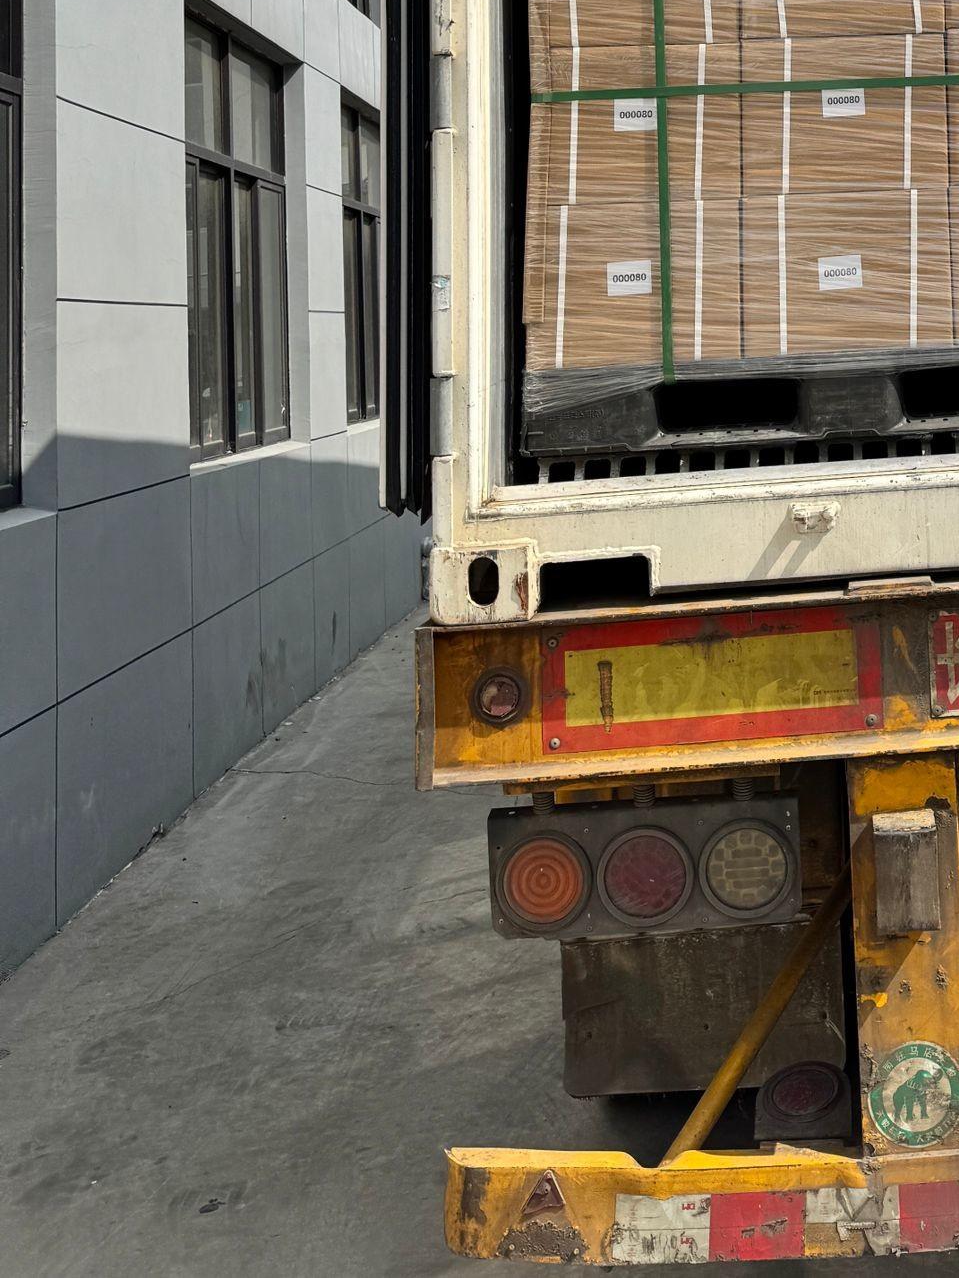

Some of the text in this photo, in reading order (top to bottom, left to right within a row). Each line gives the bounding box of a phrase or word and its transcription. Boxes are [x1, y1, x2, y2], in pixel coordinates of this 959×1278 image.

[827, 95, 860, 106] 000080
[619, 109, 654, 120] 000080
[612, 272, 647, 283] 000080
[823, 267, 858, 278] 000080
